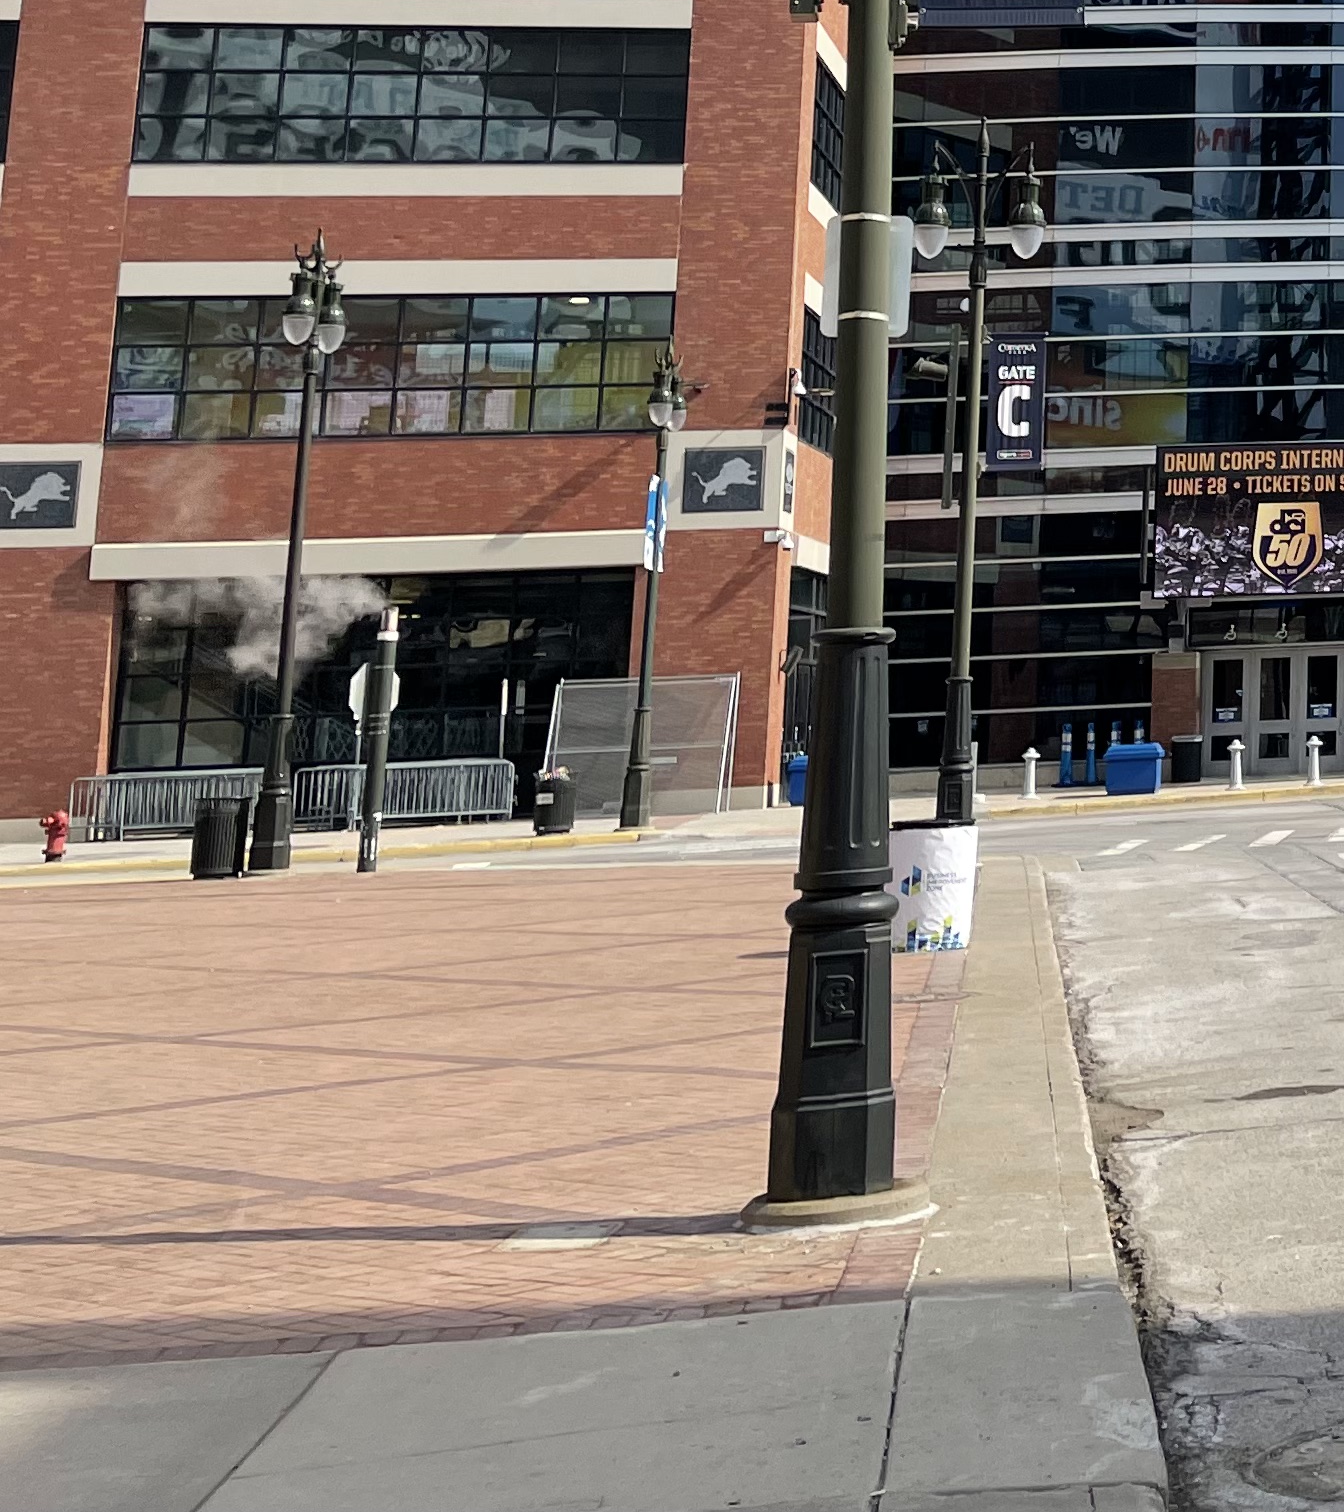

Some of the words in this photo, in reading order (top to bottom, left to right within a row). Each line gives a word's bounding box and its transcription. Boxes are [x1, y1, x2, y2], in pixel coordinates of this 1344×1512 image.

[998, 365, 1036, 380] GATE
[997, 384, 1031, 438] C
[1164, 453, 1215, 473] DRUM
[1219, 451, 1277, 471] CORPS
[1164, 477, 1203, 496] JUNE
[1207, 477, 1227, 495] 28
[1246, 475, 1311, 494] TICKETS
[1314, 474, 1336, 492] ON
[1266, 533, 1310, 567] 50
